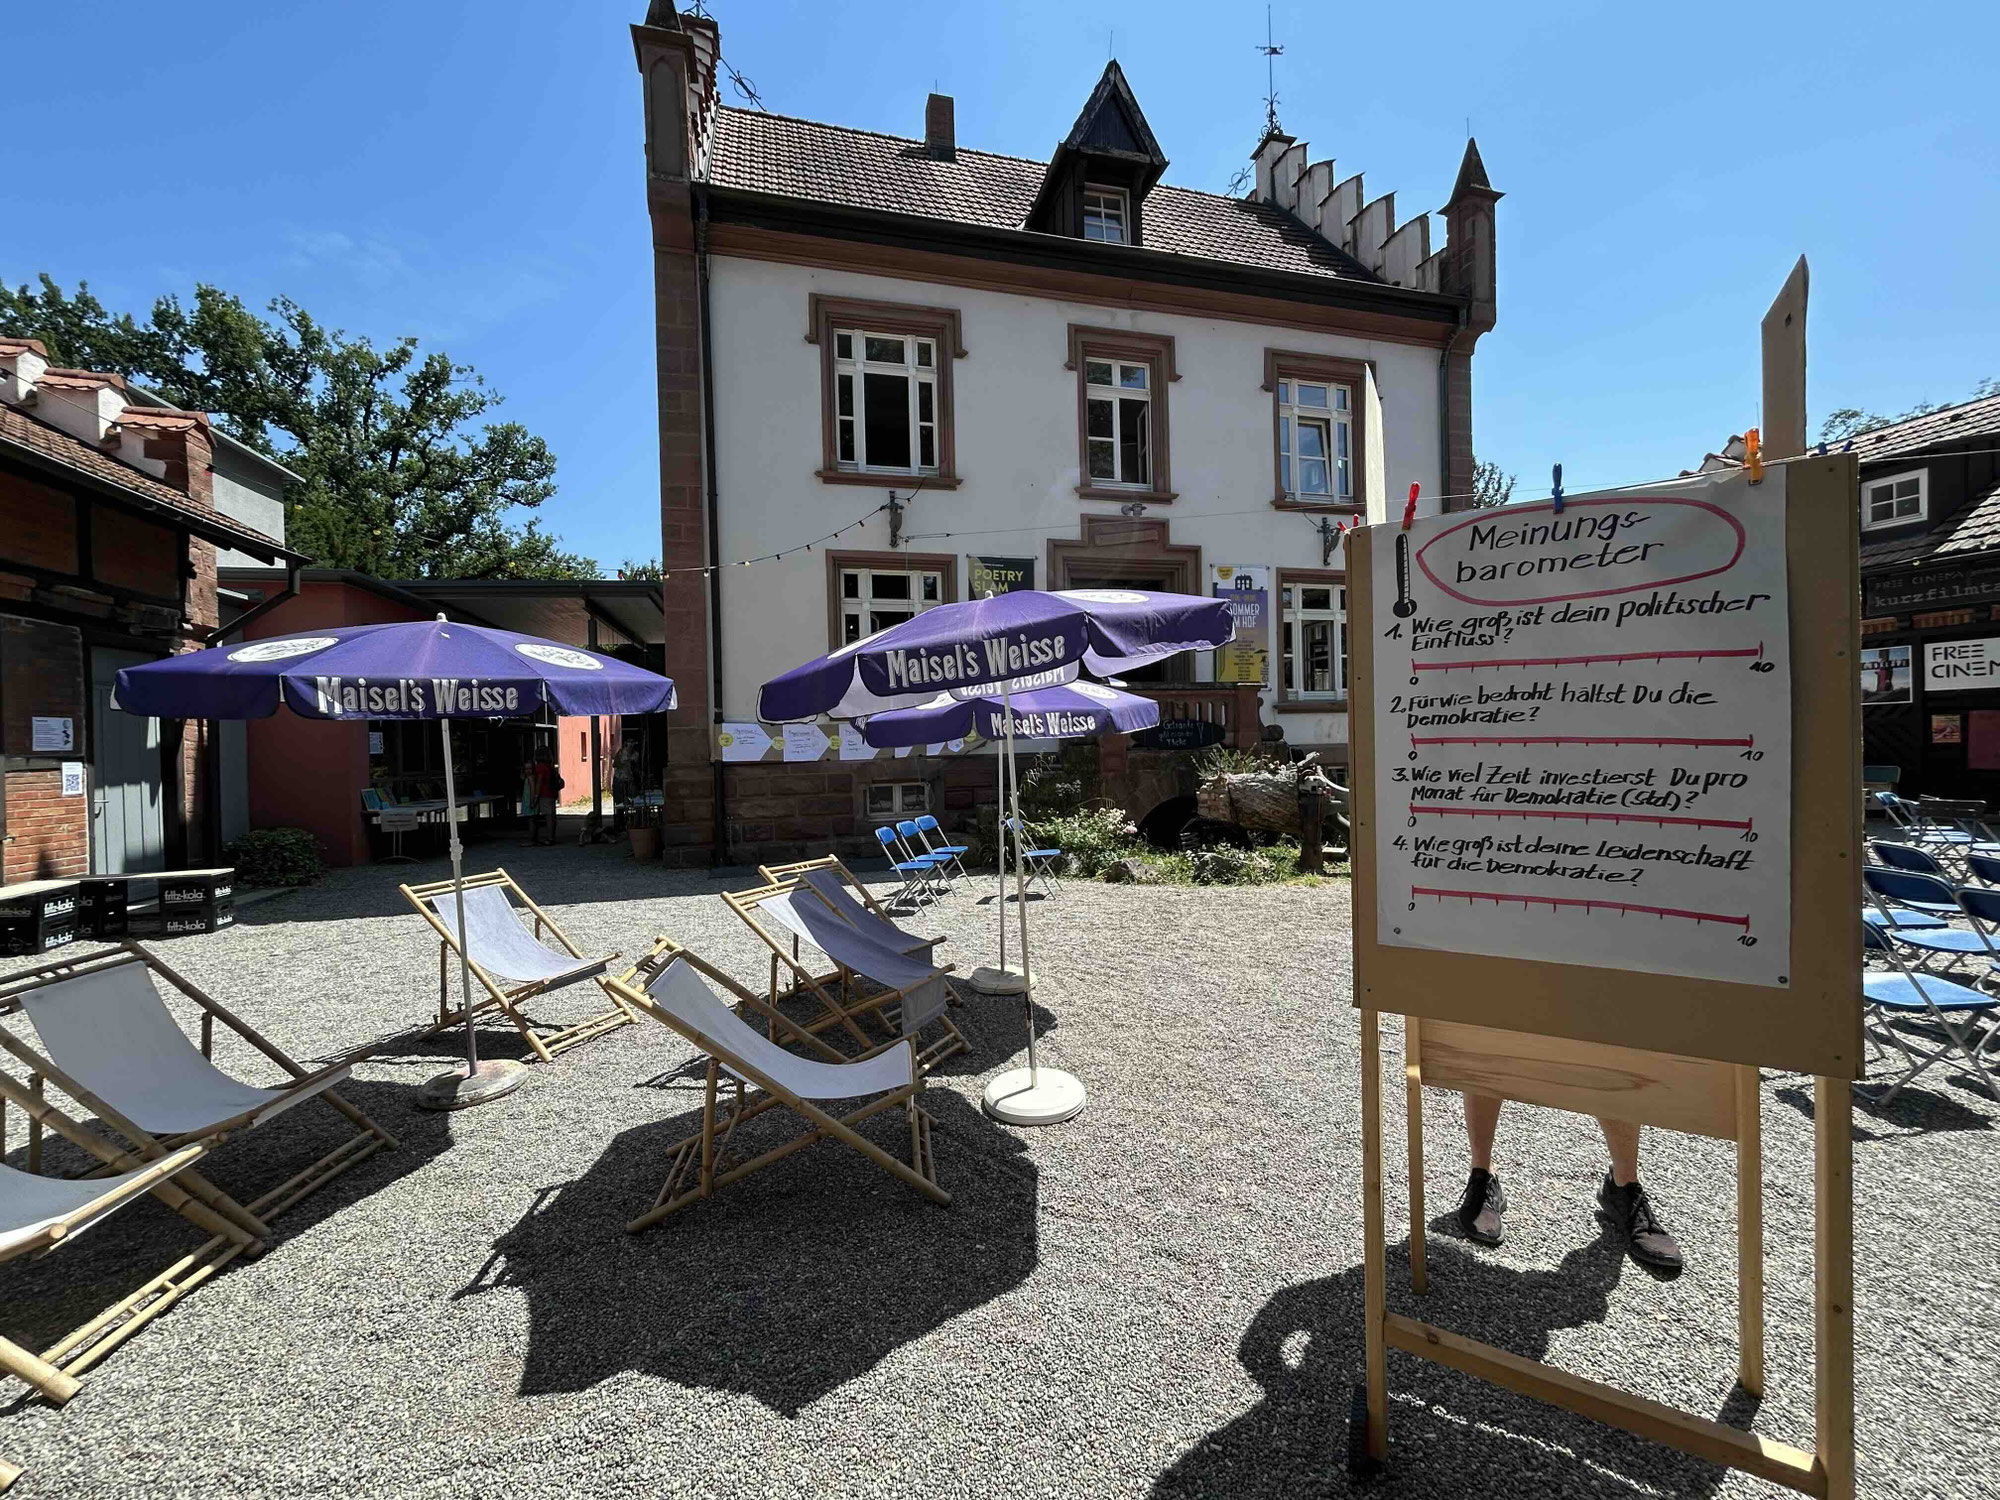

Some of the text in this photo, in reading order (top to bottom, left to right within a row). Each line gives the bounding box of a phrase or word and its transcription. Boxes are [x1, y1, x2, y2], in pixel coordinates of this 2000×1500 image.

[1468, 511, 1652, 551] Meinungs-
[1456, 542, 1664, 583] barometer
[974, 568, 1024, 581] POETRY
[974, 581, 1009, 593] SLAM
[1242, 615, 1257, 628] HOF
[1384, 590, 1771, 640] 1. Wie groß ist dein politischer
[1932, 643, 1984, 661] FREE
[886, 633, 1066, 689] Maisel's Weisse
[1749, 661, 1775, 673] 10
[1409, 676, 1419, 686] 0
[315, 676, 519, 714] Maisel's Weisse
[1390, 696, 1407, 713] 2.
[1477, 682, 1557, 704] bedroht
[1560, 682, 1627, 703] hältst
[1632, 685, 1663, 704] Du
[1668, 681, 1719, 705] die
[1046, 711, 1096, 736] Weisse
[1407, 706, 1541, 729] Demokratie?
[1408, 750, 1418, 761] 0
[1739, 751, 1764, 761] 10
[1392, 762, 1748, 794] 3. Wie viel Zeit investierst Du pro
[1411, 785, 1465, 801] Monat
[1469, 786, 1502, 803] für
[1504, 786, 1618, 805] Demokratie
[1407, 816, 1417, 827] 0
[1739, 830, 1758, 842] 10
[1392, 835, 1408, 850] 4.
[1414, 835, 1450, 852] Wie
[1452, 835, 1494, 858] groß
[1497, 834, 1522, 852] ist
[1524, 835, 1590, 856] deine
[1411, 852, 1645, 887] für die Demokratie?
[164, 889, 204, 902] fritz-kola
[1408, 902, 1416, 911] 0
[167, 919, 206, 932] fritz-kola
[1737, 935, 1758, 946] 10
